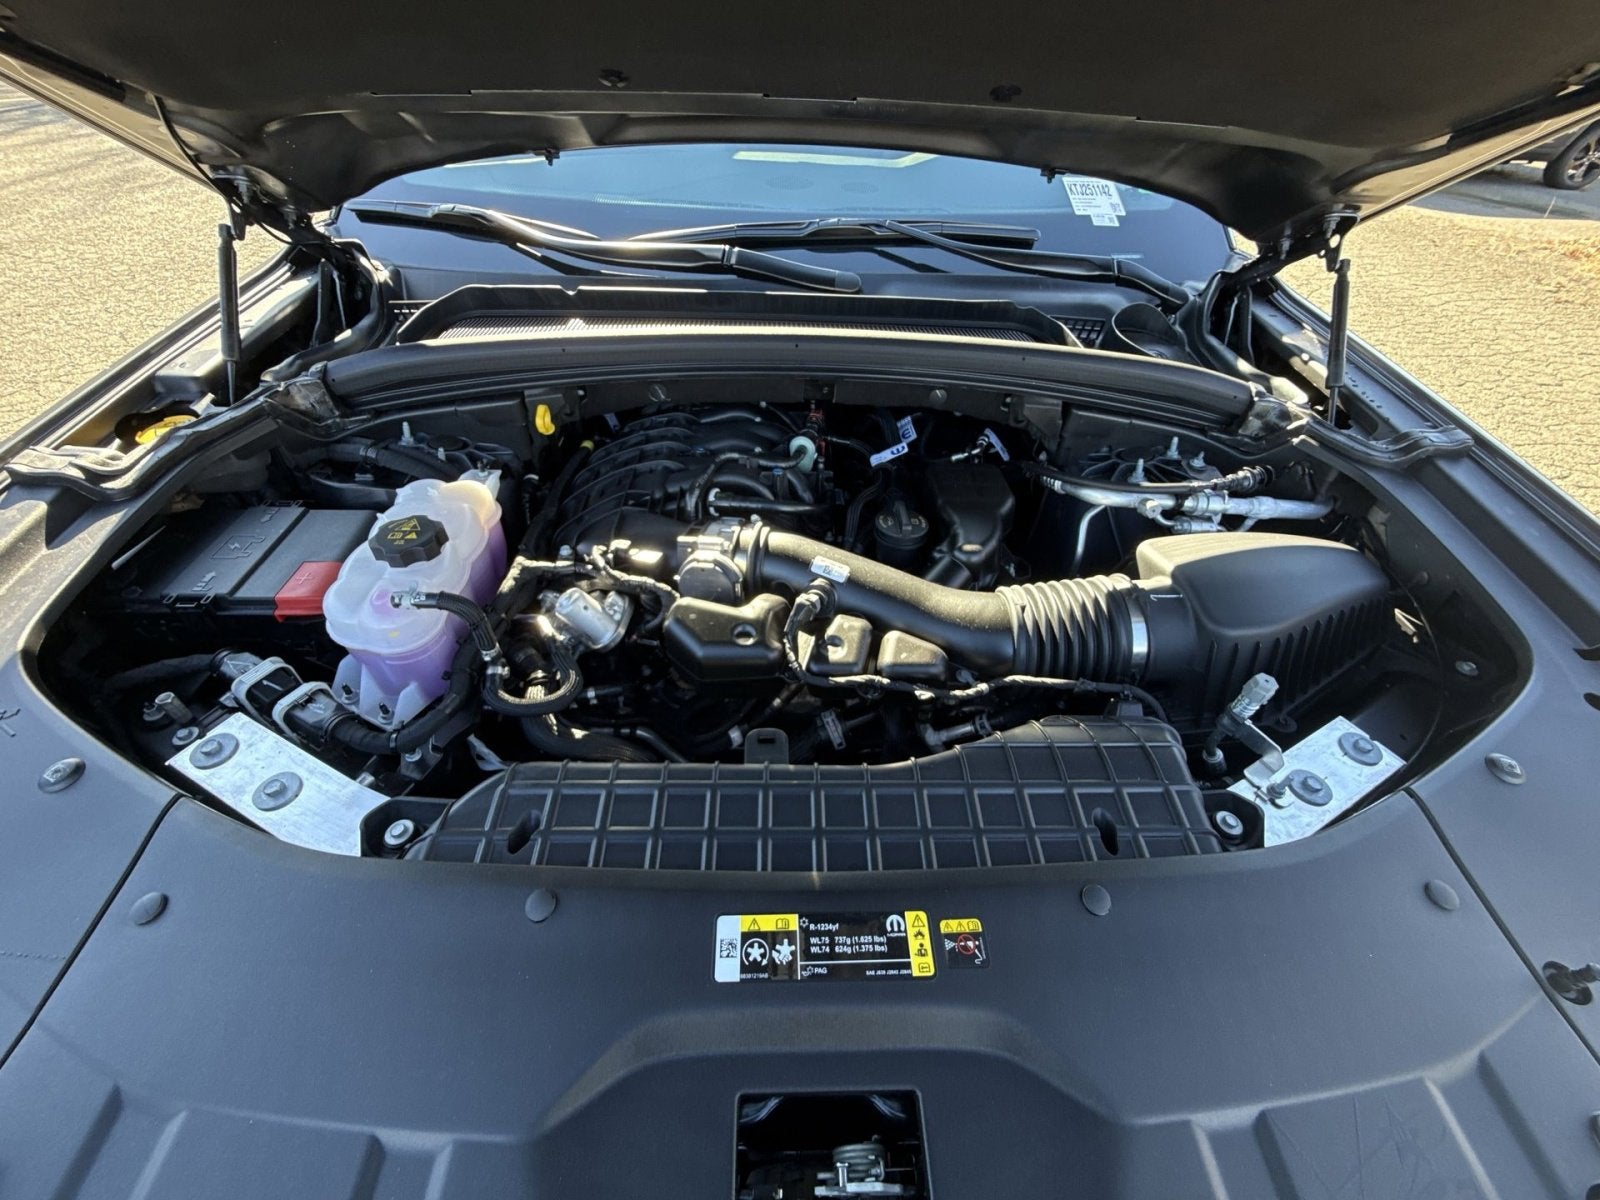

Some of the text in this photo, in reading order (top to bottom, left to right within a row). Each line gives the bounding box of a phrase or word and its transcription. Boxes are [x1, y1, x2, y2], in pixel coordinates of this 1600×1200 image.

[1066, 183, 1112, 197] KTJ251142
[809, 923, 840, 932] R-1234yf
[810, 936, 830, 944] WL75
[834, 936, 851, 945] 737g
[874, 935, 887, 943] lbs)
[810, 944, 888, 954] WL74 624g (1.375 lbs)
[814, 966, 828, 974] PAG
